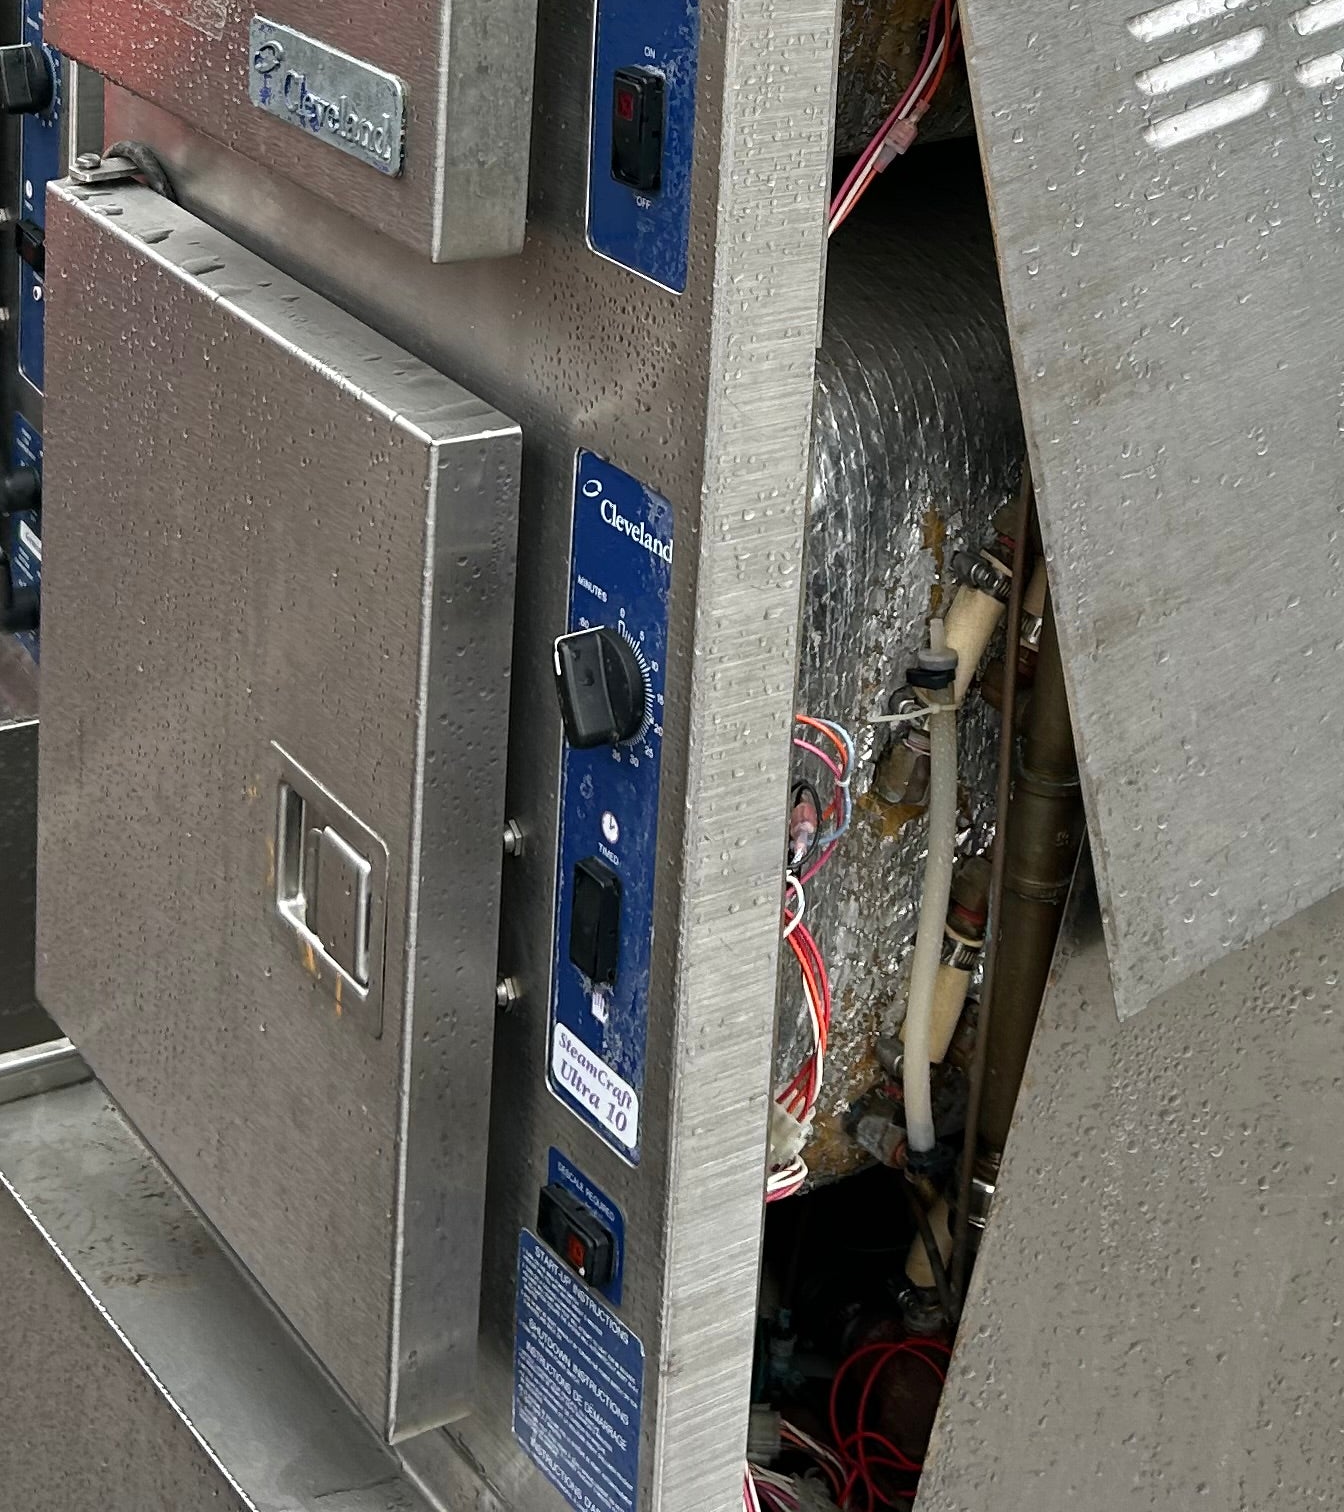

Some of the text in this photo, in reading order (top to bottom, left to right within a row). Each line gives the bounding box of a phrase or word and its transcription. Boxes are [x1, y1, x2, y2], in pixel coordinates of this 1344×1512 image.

[644, 46, 656, 59] ON
[283, 68, 393, 161] Cleveland
[636, 196, 651, 210] OFF
[600, 499, 673, 564] Cleveland
[598, 842, 619, 866] TIMED
[559, 1032, 632, 1109] SteamCraft
[560, 1058, 627, 1132] Ultra 10
[535, 1245, 572, 1286] START-UP
[572, 1284, 629, 1345] INSTRUCTIONS
[572, 1363, 629, 1426] INSTRUCTIONS
